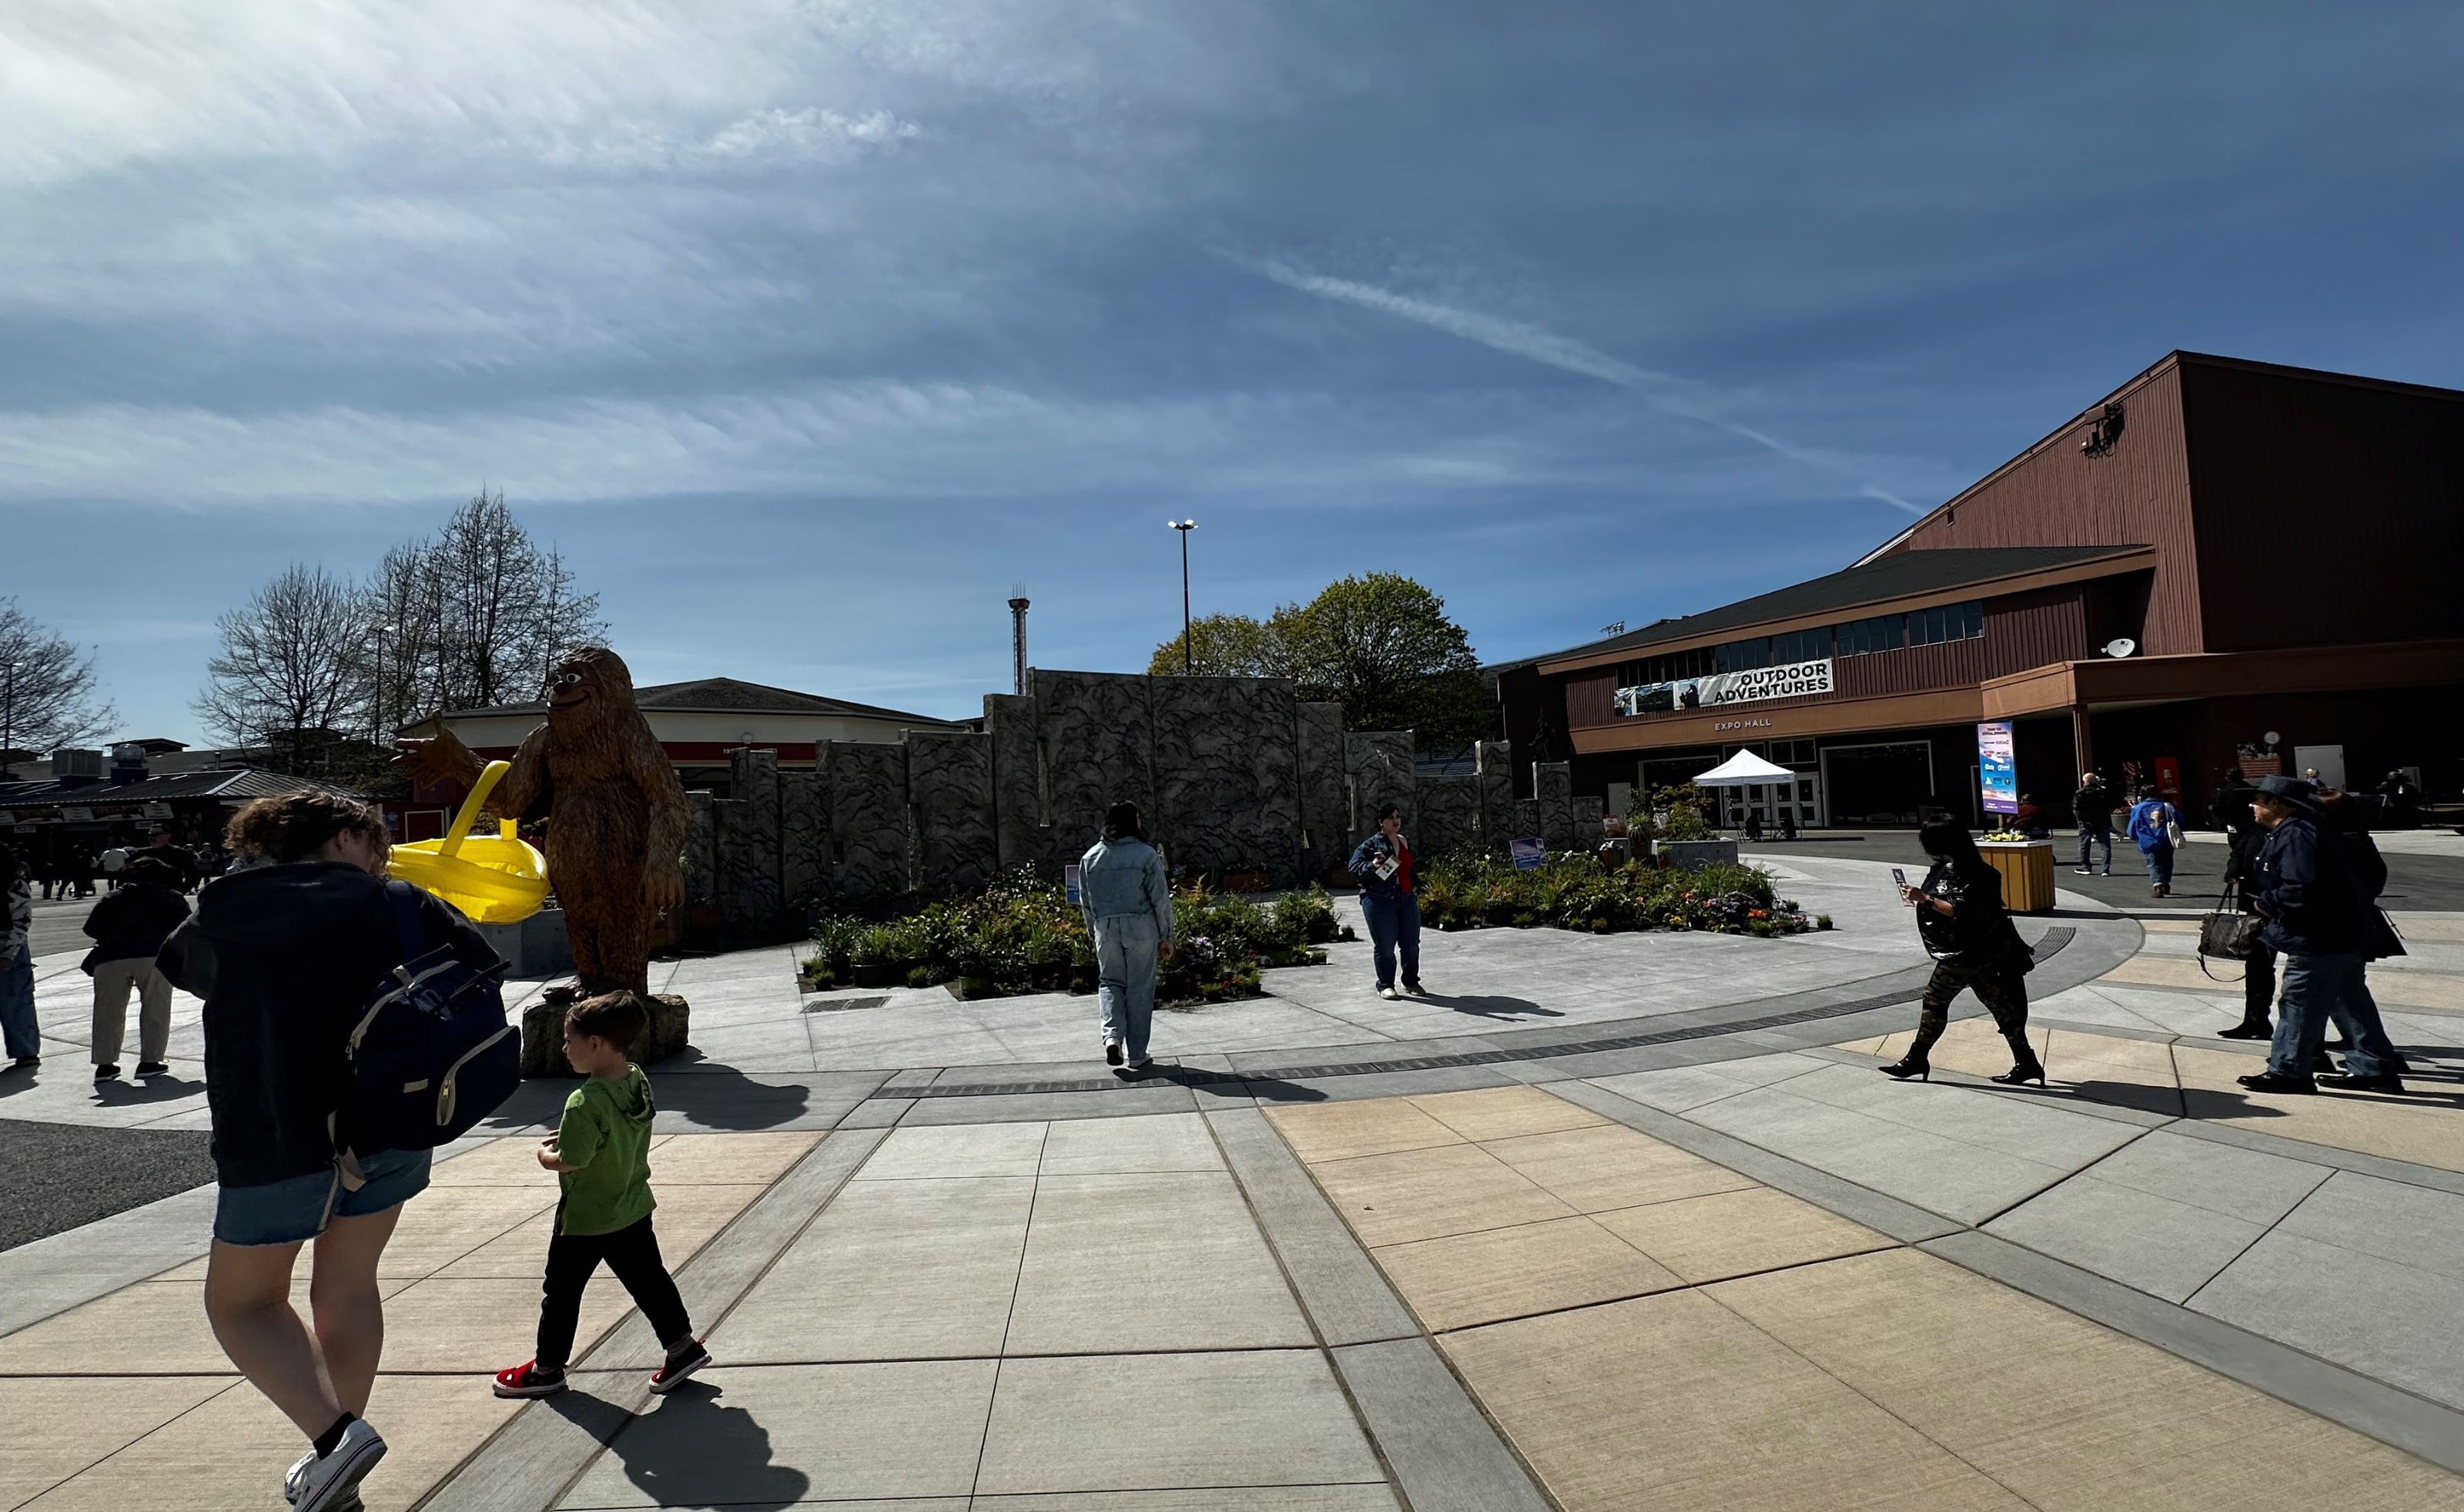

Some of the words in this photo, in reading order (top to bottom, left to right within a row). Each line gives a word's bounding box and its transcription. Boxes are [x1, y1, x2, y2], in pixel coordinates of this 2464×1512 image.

[1741, 663, 1827, 686] OUTDOOR
[1714, 677, 1829, 703] ADVENTURES
[1715, 721, 1742, 732] EXPO
[1745, 719, 1772, 728] HALL
